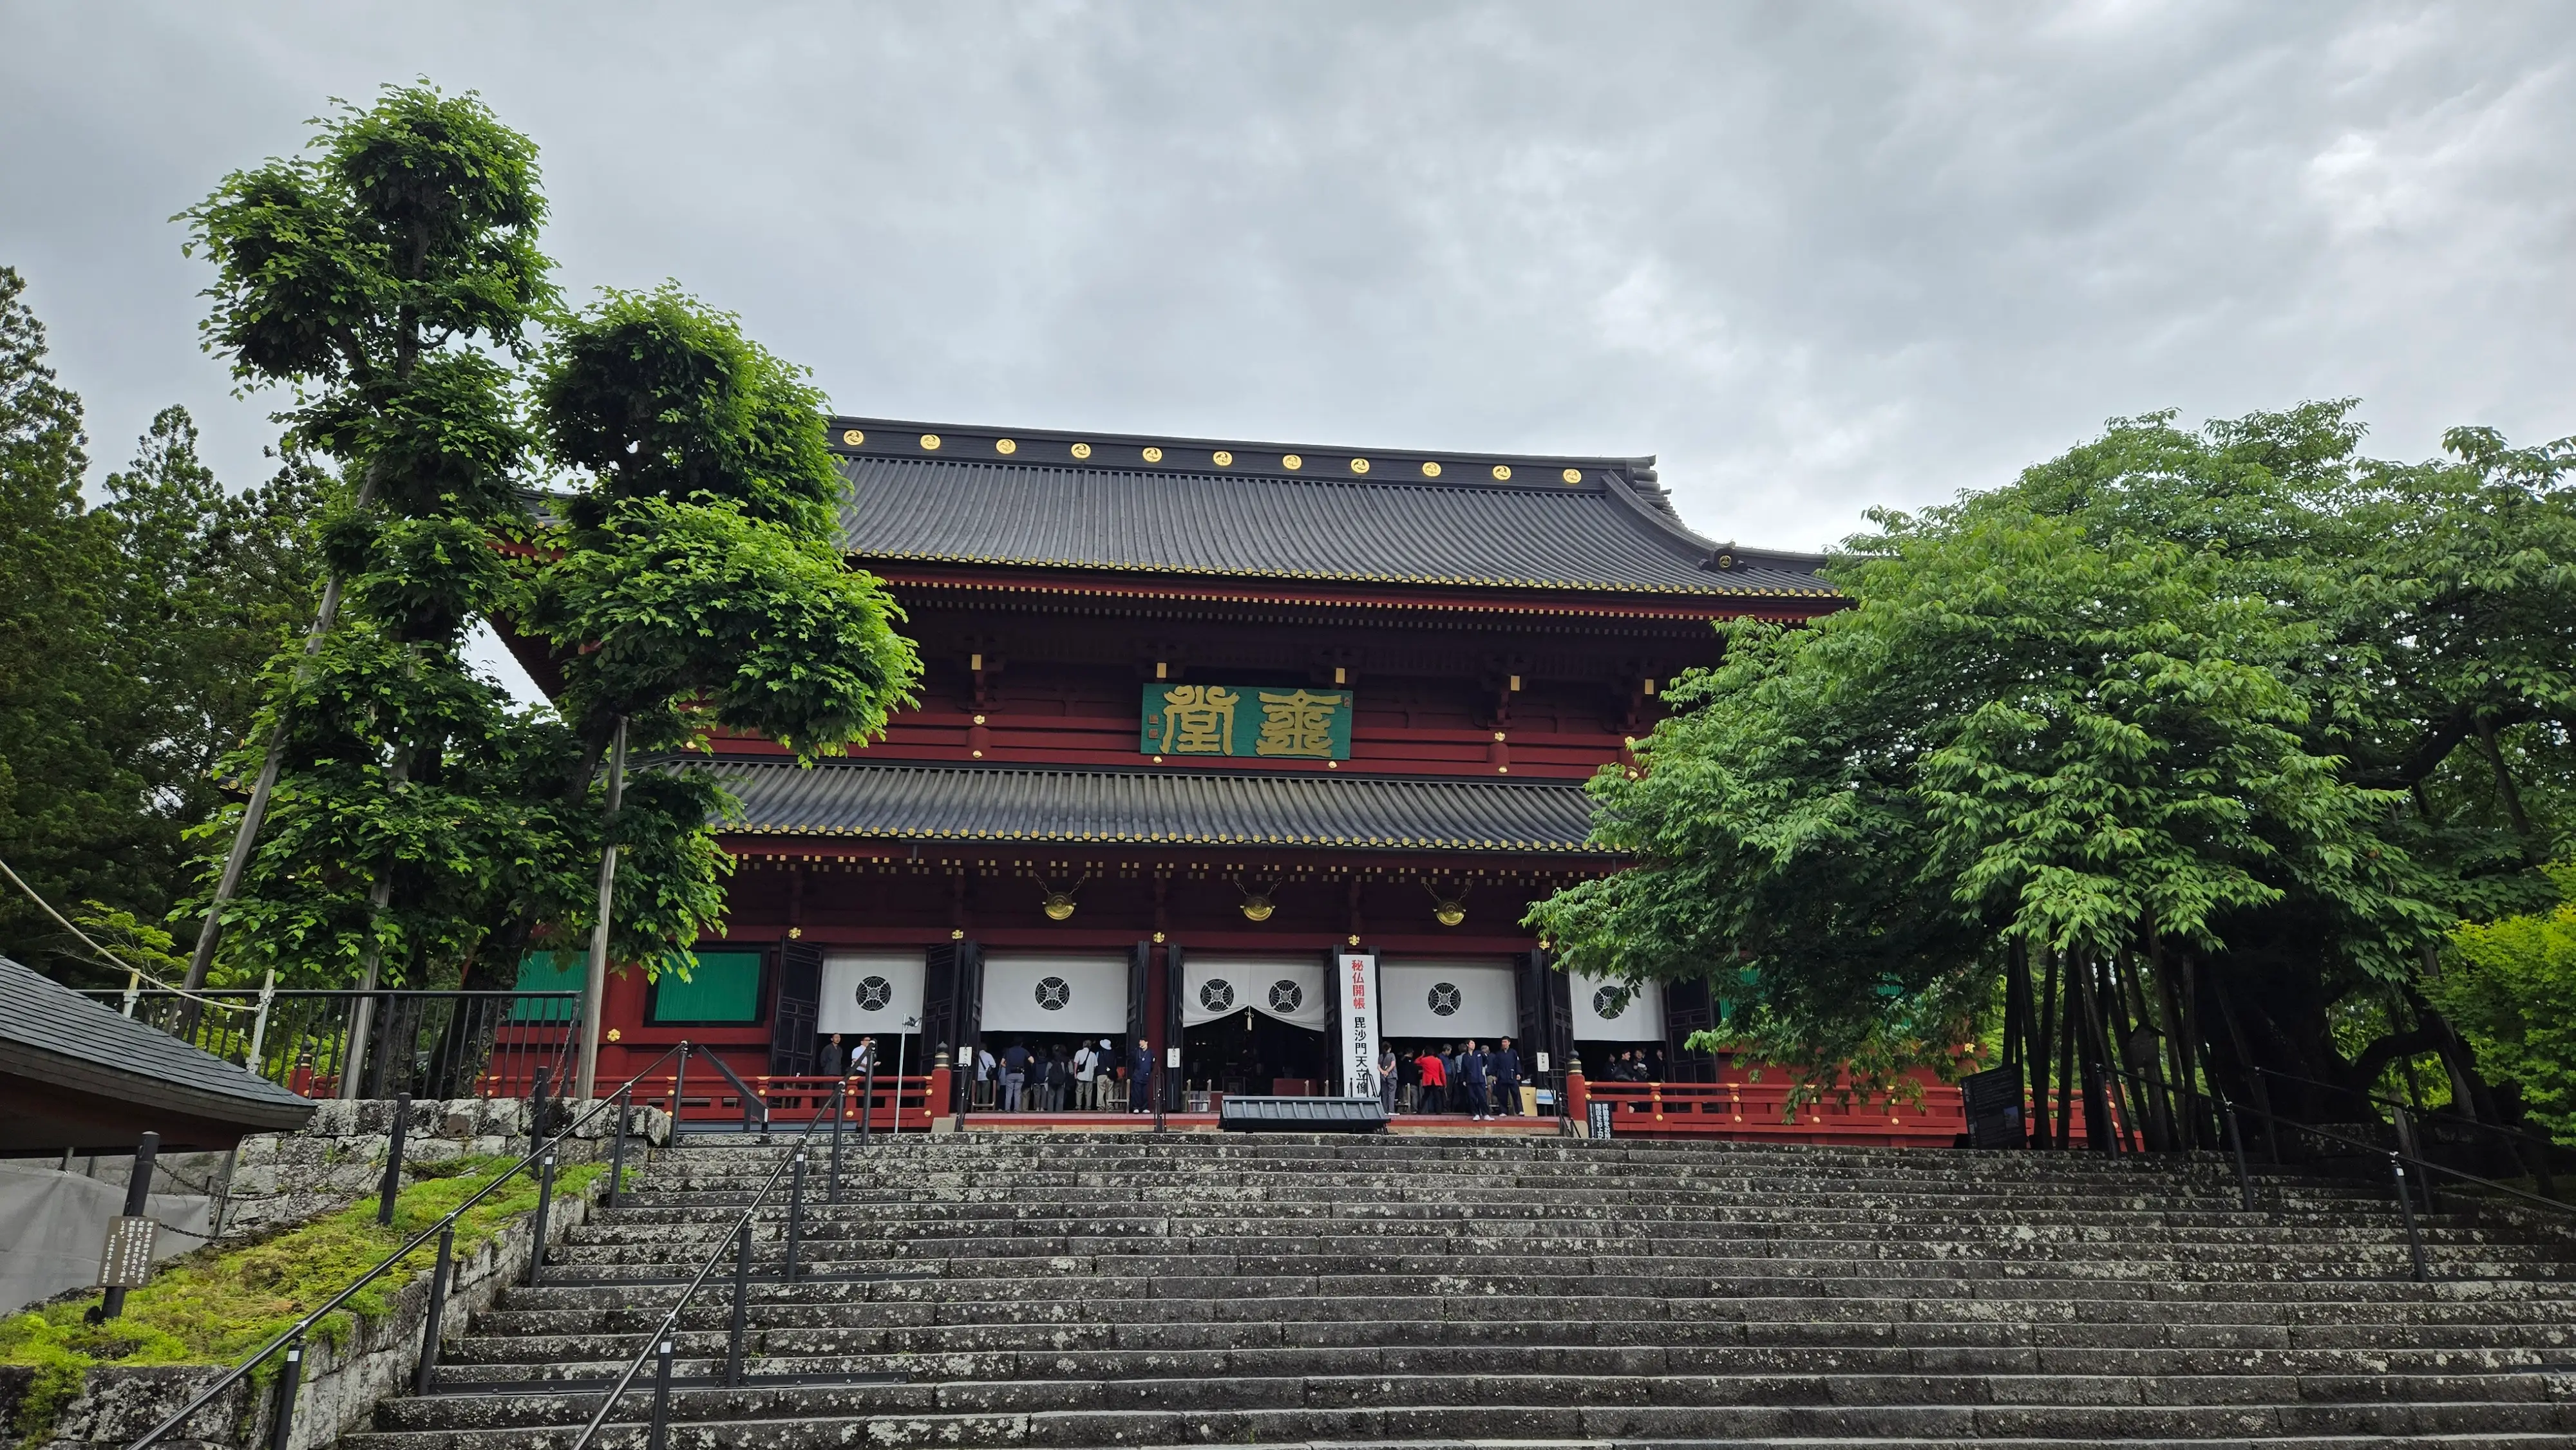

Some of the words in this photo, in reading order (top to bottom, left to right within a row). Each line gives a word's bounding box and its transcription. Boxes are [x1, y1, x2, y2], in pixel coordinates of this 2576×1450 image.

[1351, 959, 1365, 1010] 秘仏開帳
[1354, 1017, 1368, 1094] 毘沙門天立像
